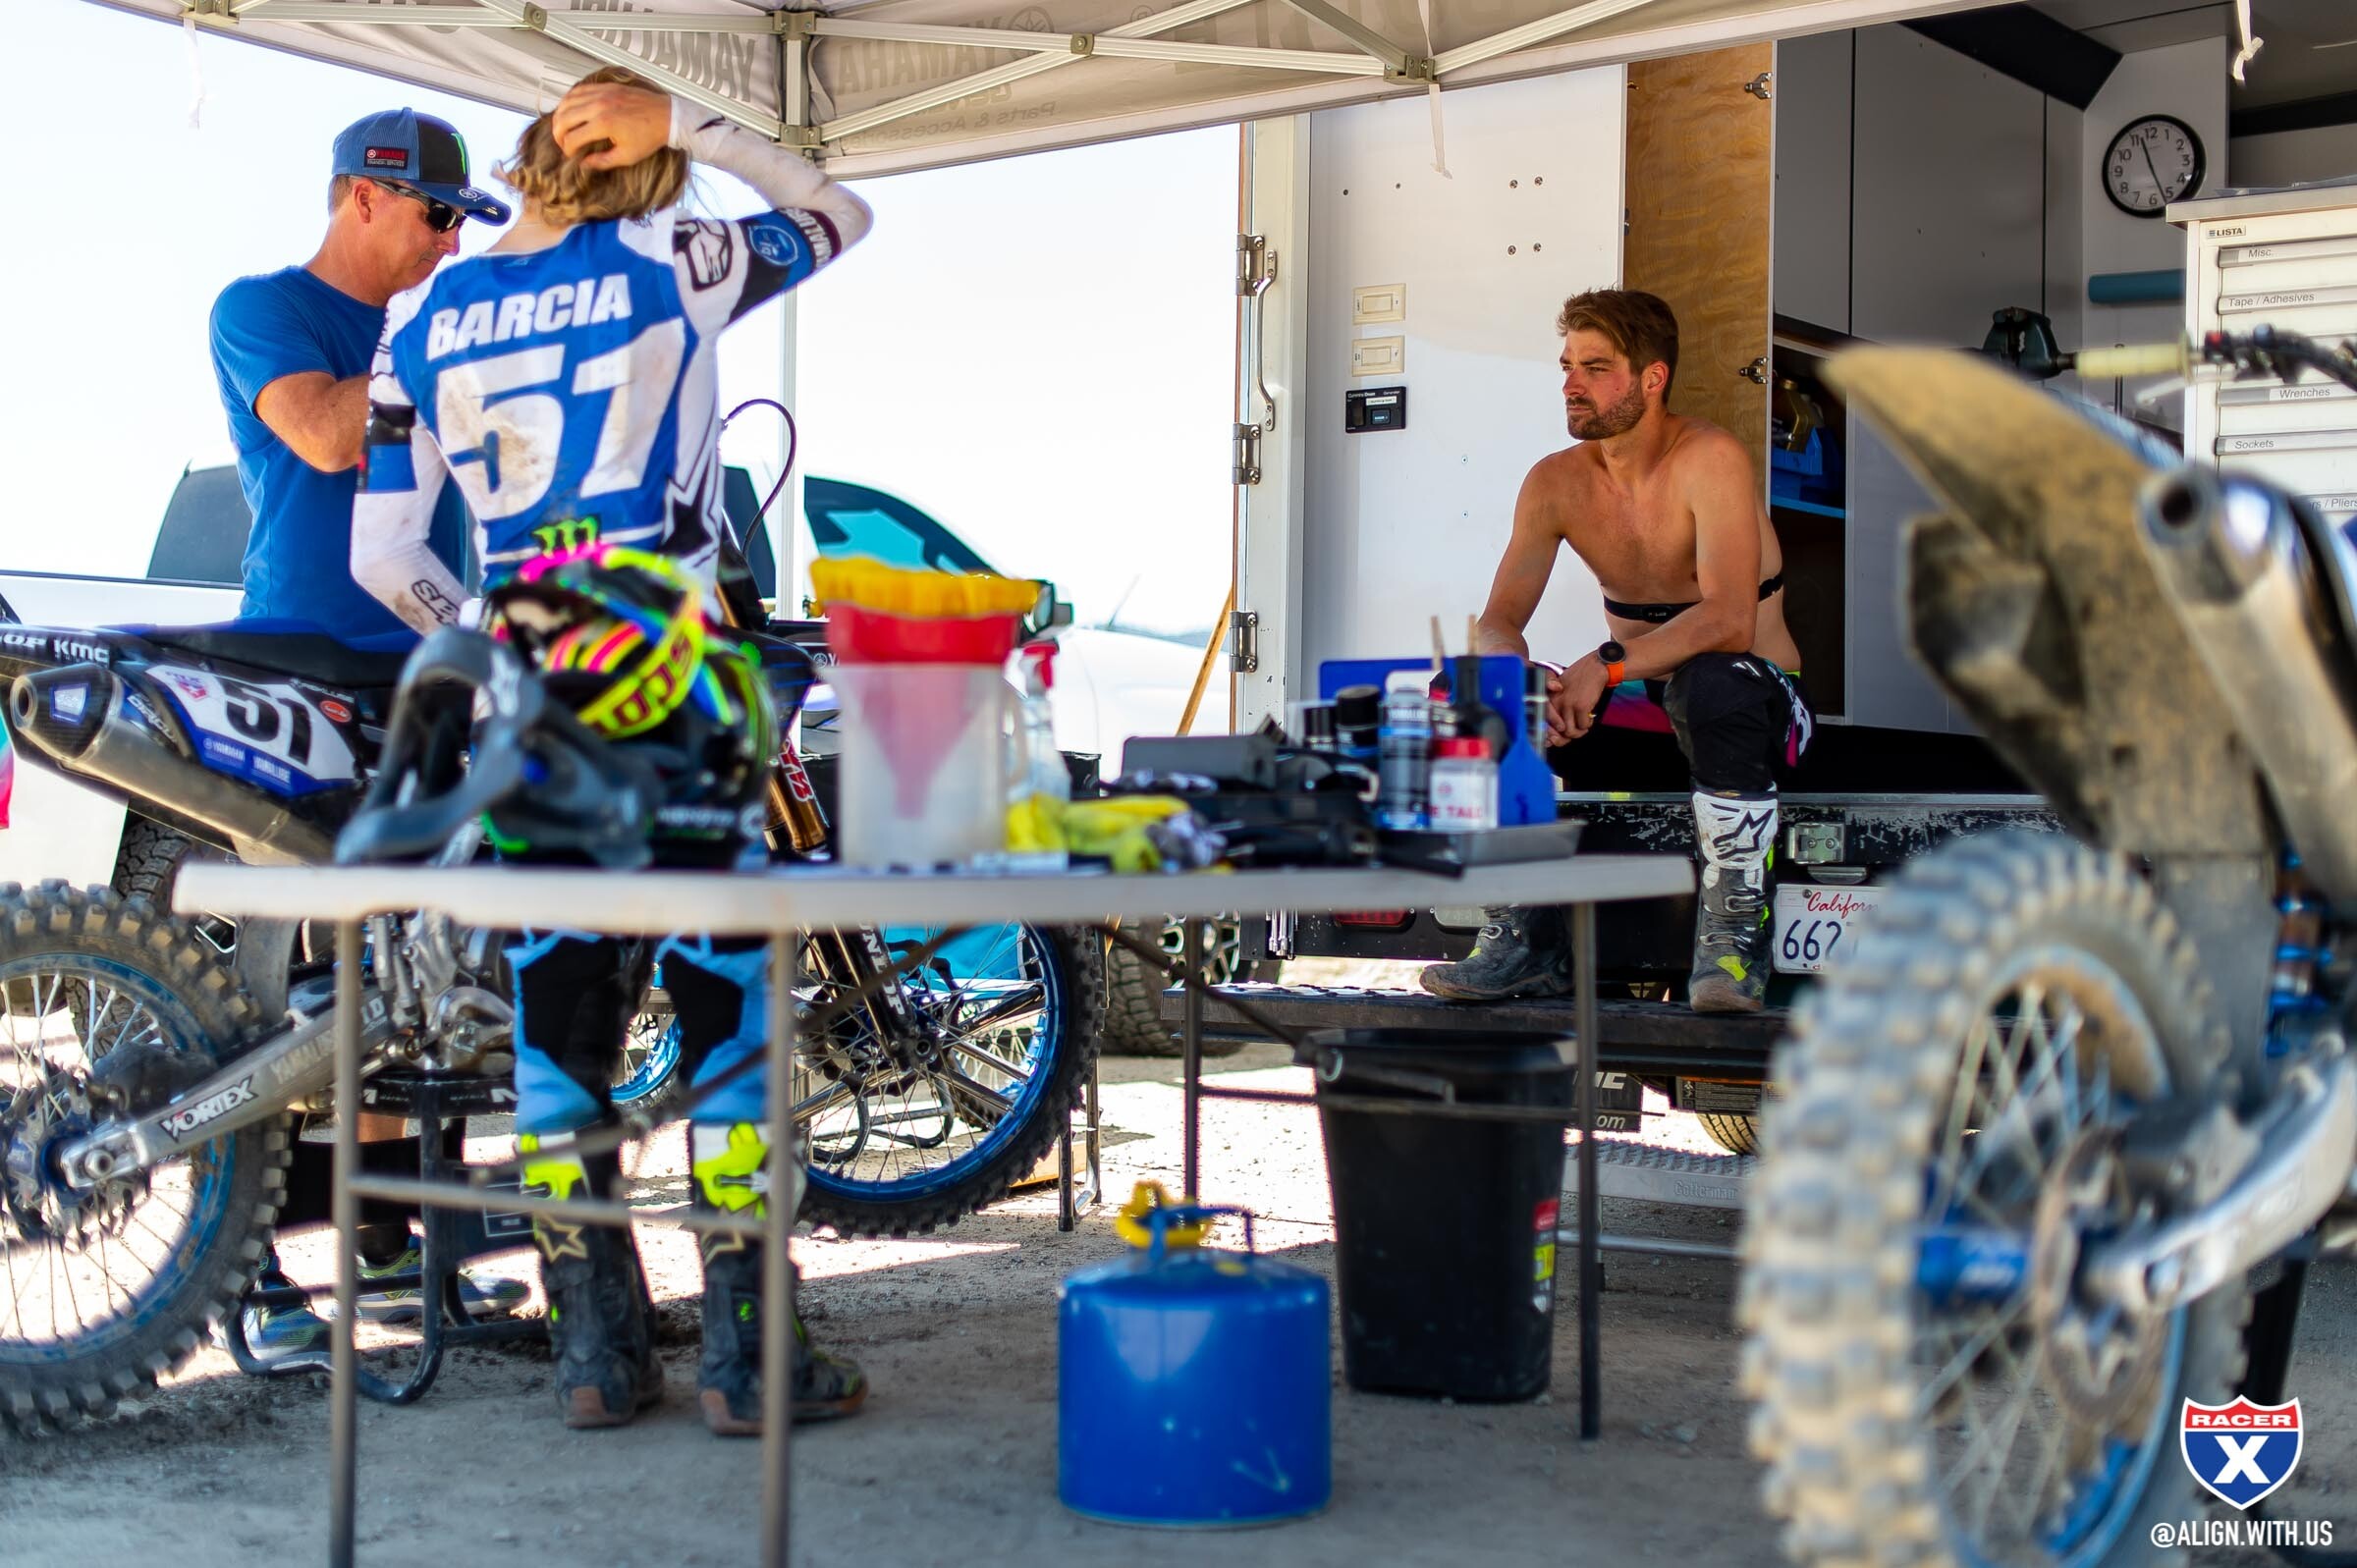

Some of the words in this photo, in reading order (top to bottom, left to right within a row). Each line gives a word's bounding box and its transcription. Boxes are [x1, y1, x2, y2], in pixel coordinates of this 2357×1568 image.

[2145, 127, 2158, 139] 12
[2165, 129, 2169, 140] 1
[2130, 134, 2140, 146] 11
[2175, 138, 2185, 151] 2
[2118, 148, 2132, 163] 10
[2182, 154, 2191, 166] 3
[2113, 165, 2123, 177] 9
[2176, 173, 2185, 185] 4
[2120, 182, 2129, 193] 8
[2165, 187, 2174, 198] 5
[2132, 191, 2140, 204] 7
[2149, 193, 2158, 205] 6
[2216, 227, 2243, 237] LISTA
[2248, 249, 2274, 258] Misc.
[2228, 297, 2254, 308] Tape
[2263, 293, 2315, 305] Adhesives
[426, 274, 632, 362] BARCIA
[2279, 388, 2330, 399] Wrenches
[436, 317, 686, 521] 51
[2234, 440, 2275, 450] Sockets
[2330, 497, 2357, 509] Pliers
[214, 675, 312, 766] 51
[1807, 892, 1879, 919] Californ
[1782, 919, 1843, 961] 662
[160, 1075, 258, 1143] VORTEX
[1596, 1114, 1626, 1130] om
